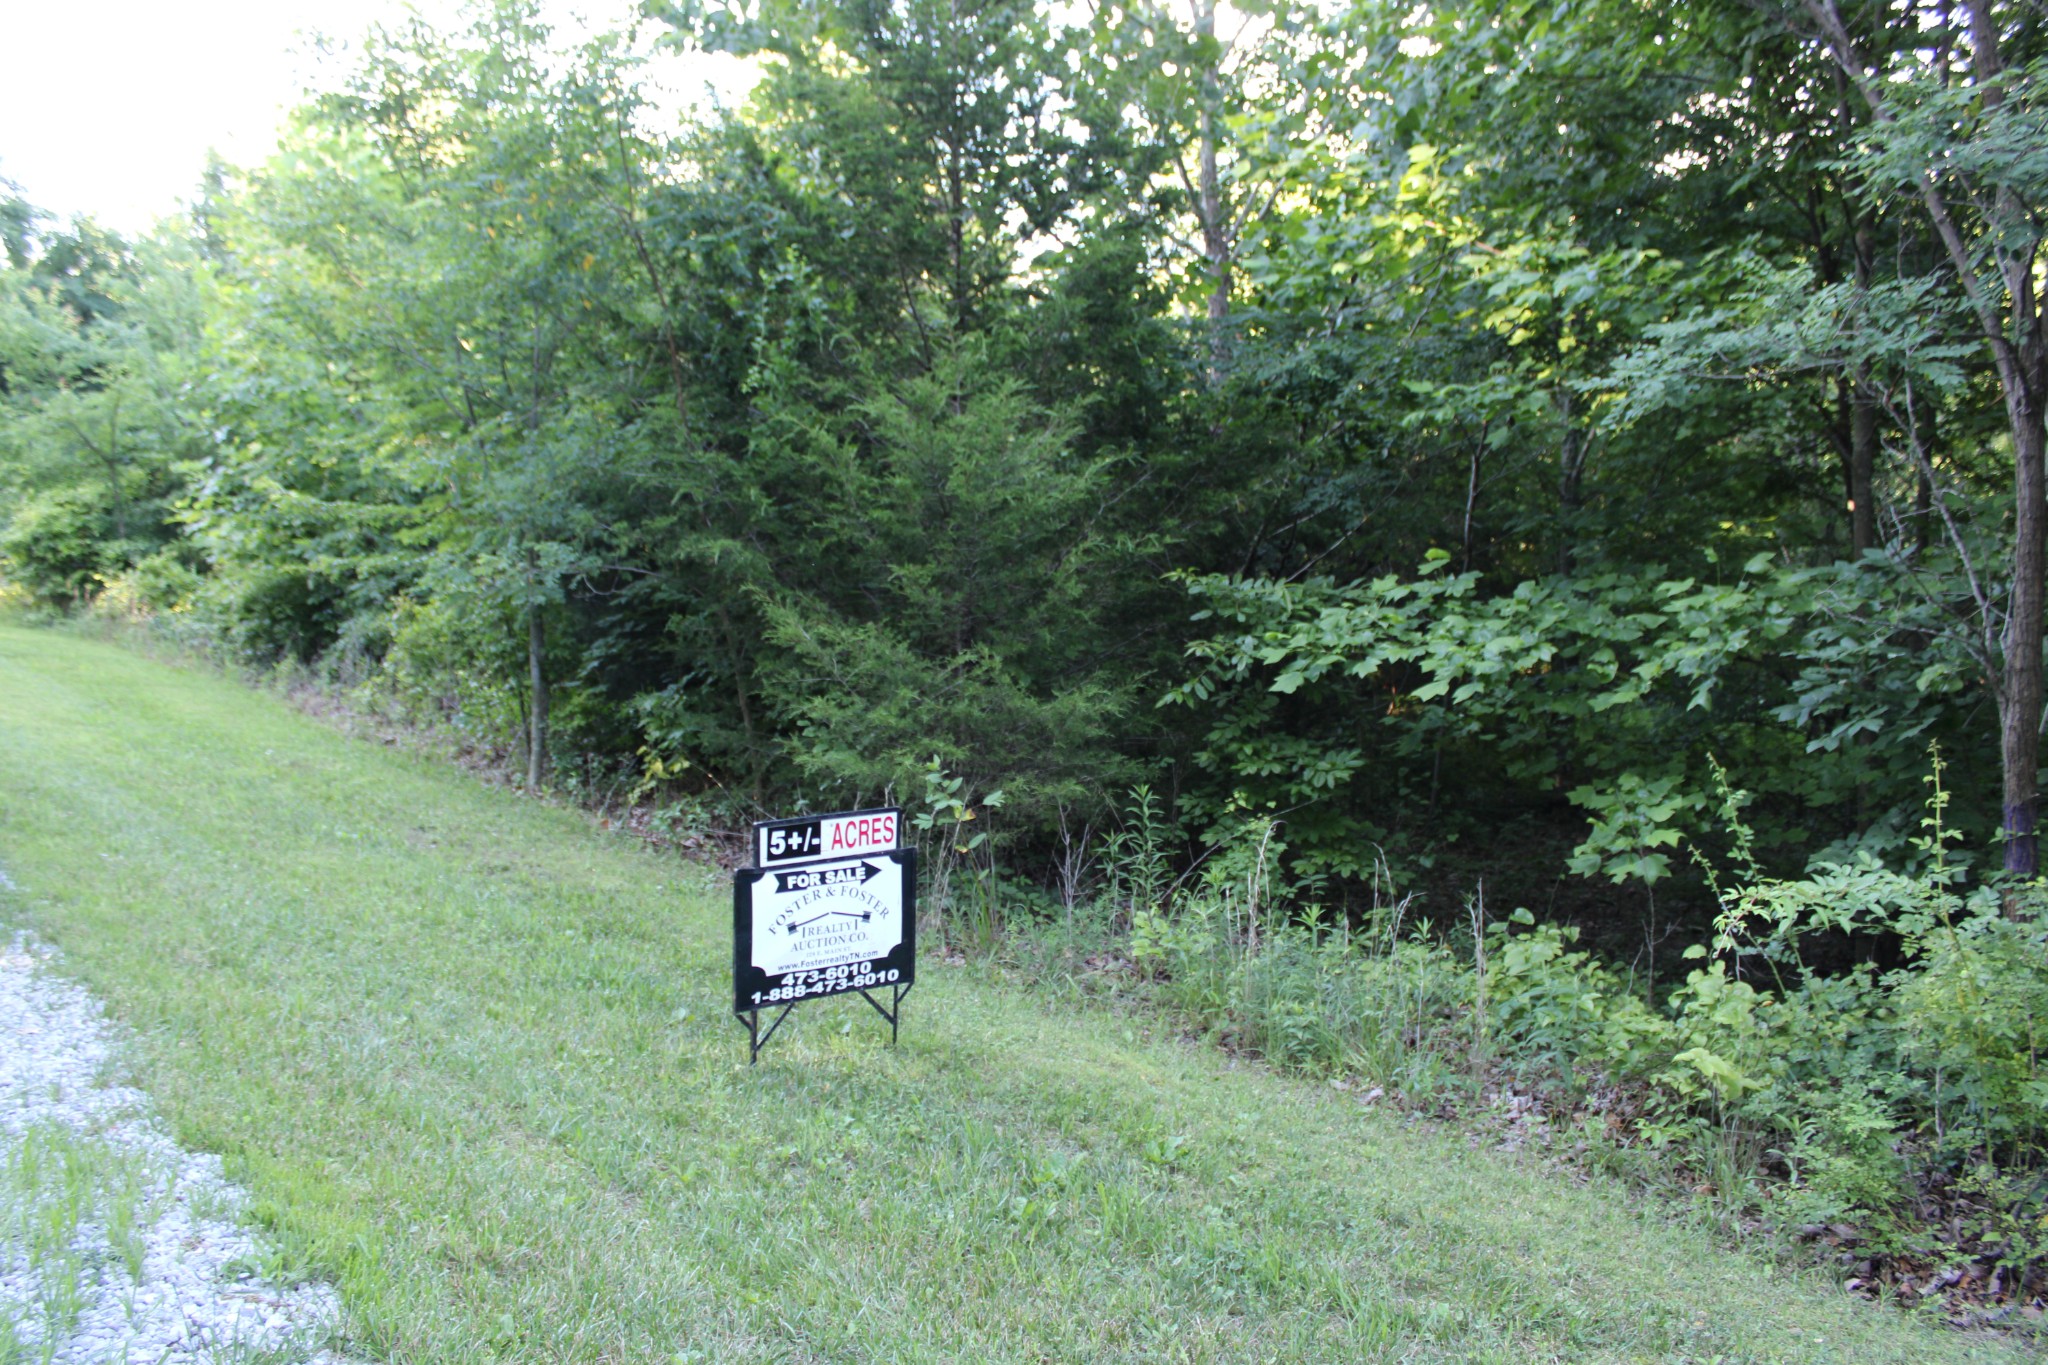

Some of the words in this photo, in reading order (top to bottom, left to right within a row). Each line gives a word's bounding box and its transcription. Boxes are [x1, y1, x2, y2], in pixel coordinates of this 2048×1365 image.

[769, 827, 820, 856] 5+/-
[831, 816, 895, 850] ACRES
[787, 872, 821, 889] FOR
[825, 867, 866, 885] SALE
[768, 887, 822, 935] FOSTER
[825, 886, 837, 897] &
[840, 885, 890, 920] FOSTER
[807, 921, 853, 937] REALTY
[790, 934, 845, 952] AUCTION
[849, 931, 869, 943] CO.
[777, 949, 879, 971] www.FosterrealtyTN.com
[781, 961, 872, 986] 473-6010
[751, 969, 900, 1004] 1-888-473-6010
